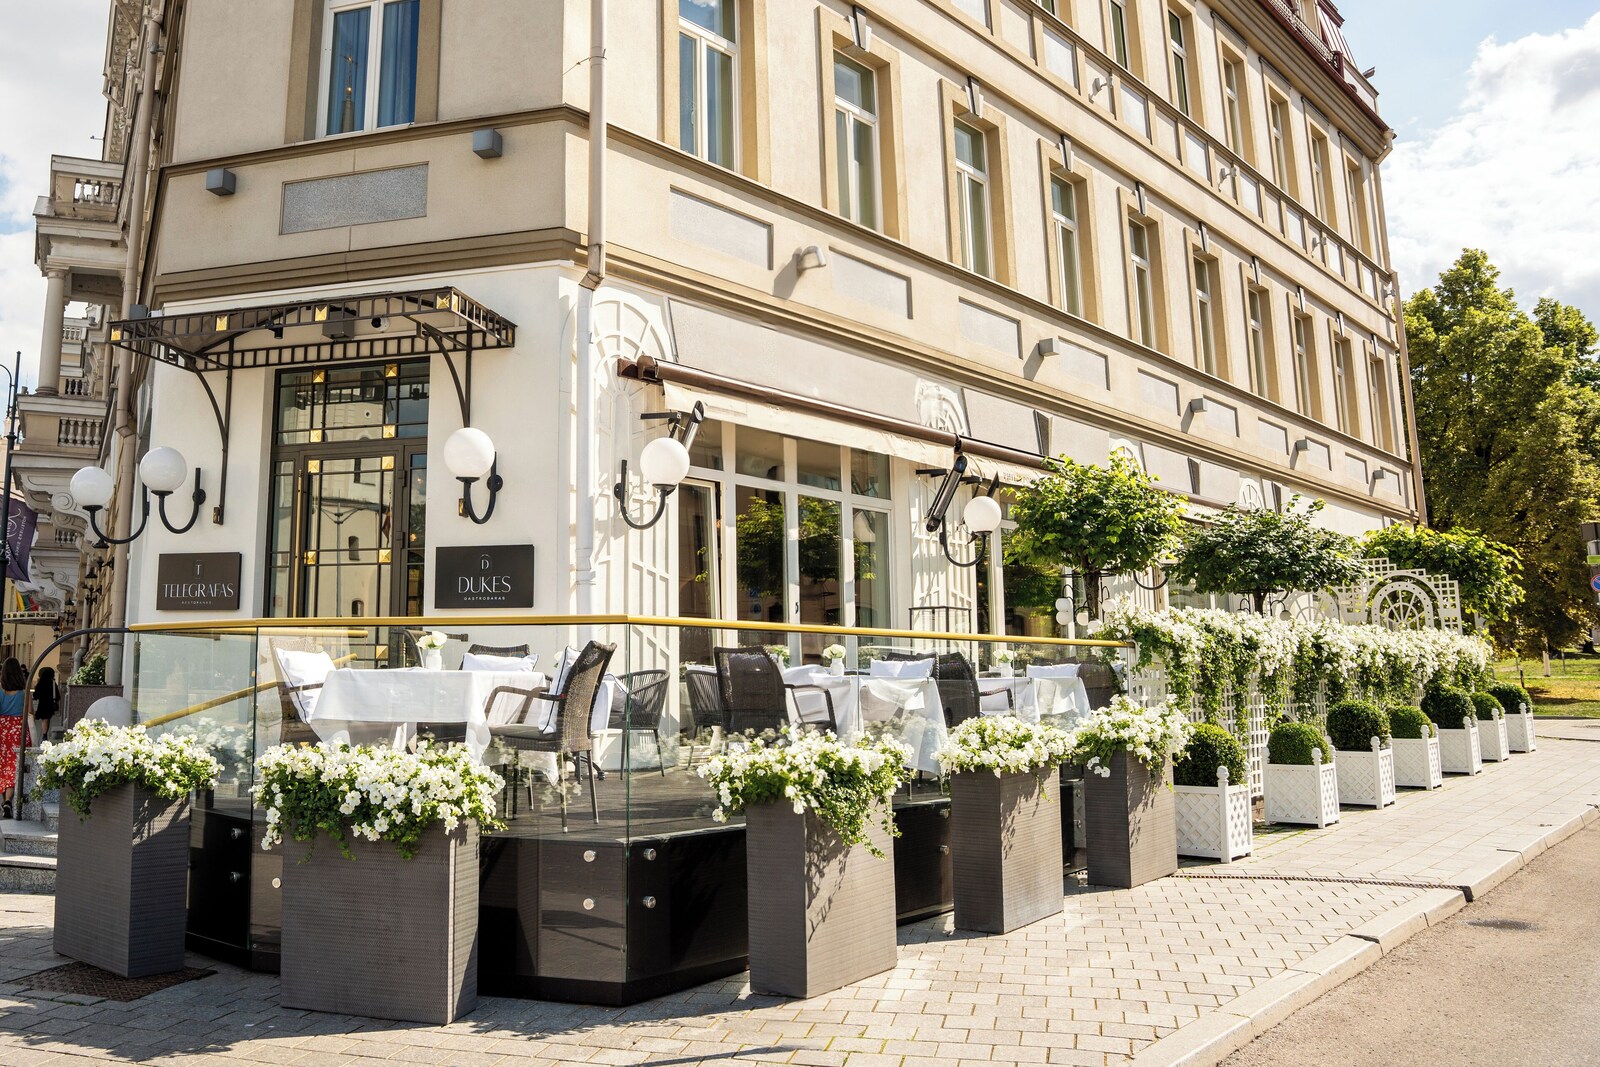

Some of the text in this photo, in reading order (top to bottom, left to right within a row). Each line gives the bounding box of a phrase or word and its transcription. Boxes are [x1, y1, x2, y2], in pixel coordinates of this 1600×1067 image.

[195, 564, 202, 575] T
[481, 559, 490, 570] D
[162, 582, 234, 598] TELEGRAFAS
[458, 575, 511, 593] DUKES
